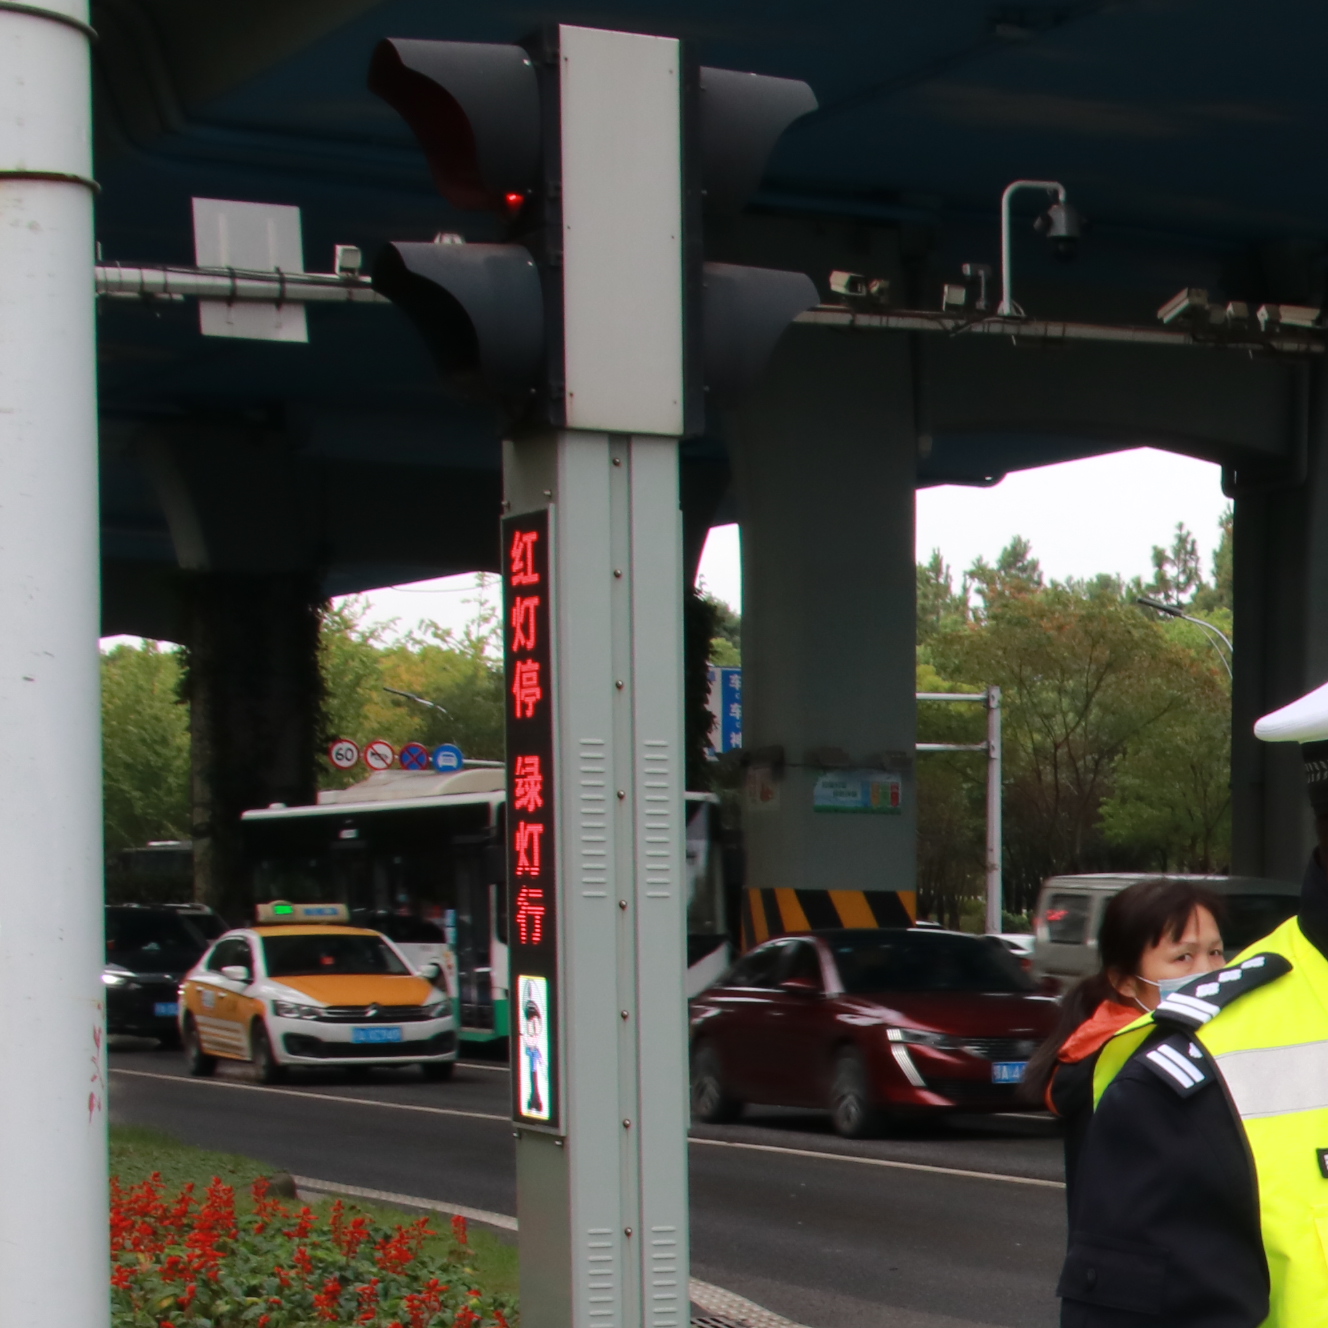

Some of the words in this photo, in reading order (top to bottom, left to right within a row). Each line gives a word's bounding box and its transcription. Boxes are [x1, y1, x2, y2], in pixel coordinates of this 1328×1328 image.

[509, 529, 543, 719] 红灯停
[334, 747, 355, 762] 60
[513, 754, 546, 945] 绿灯行
